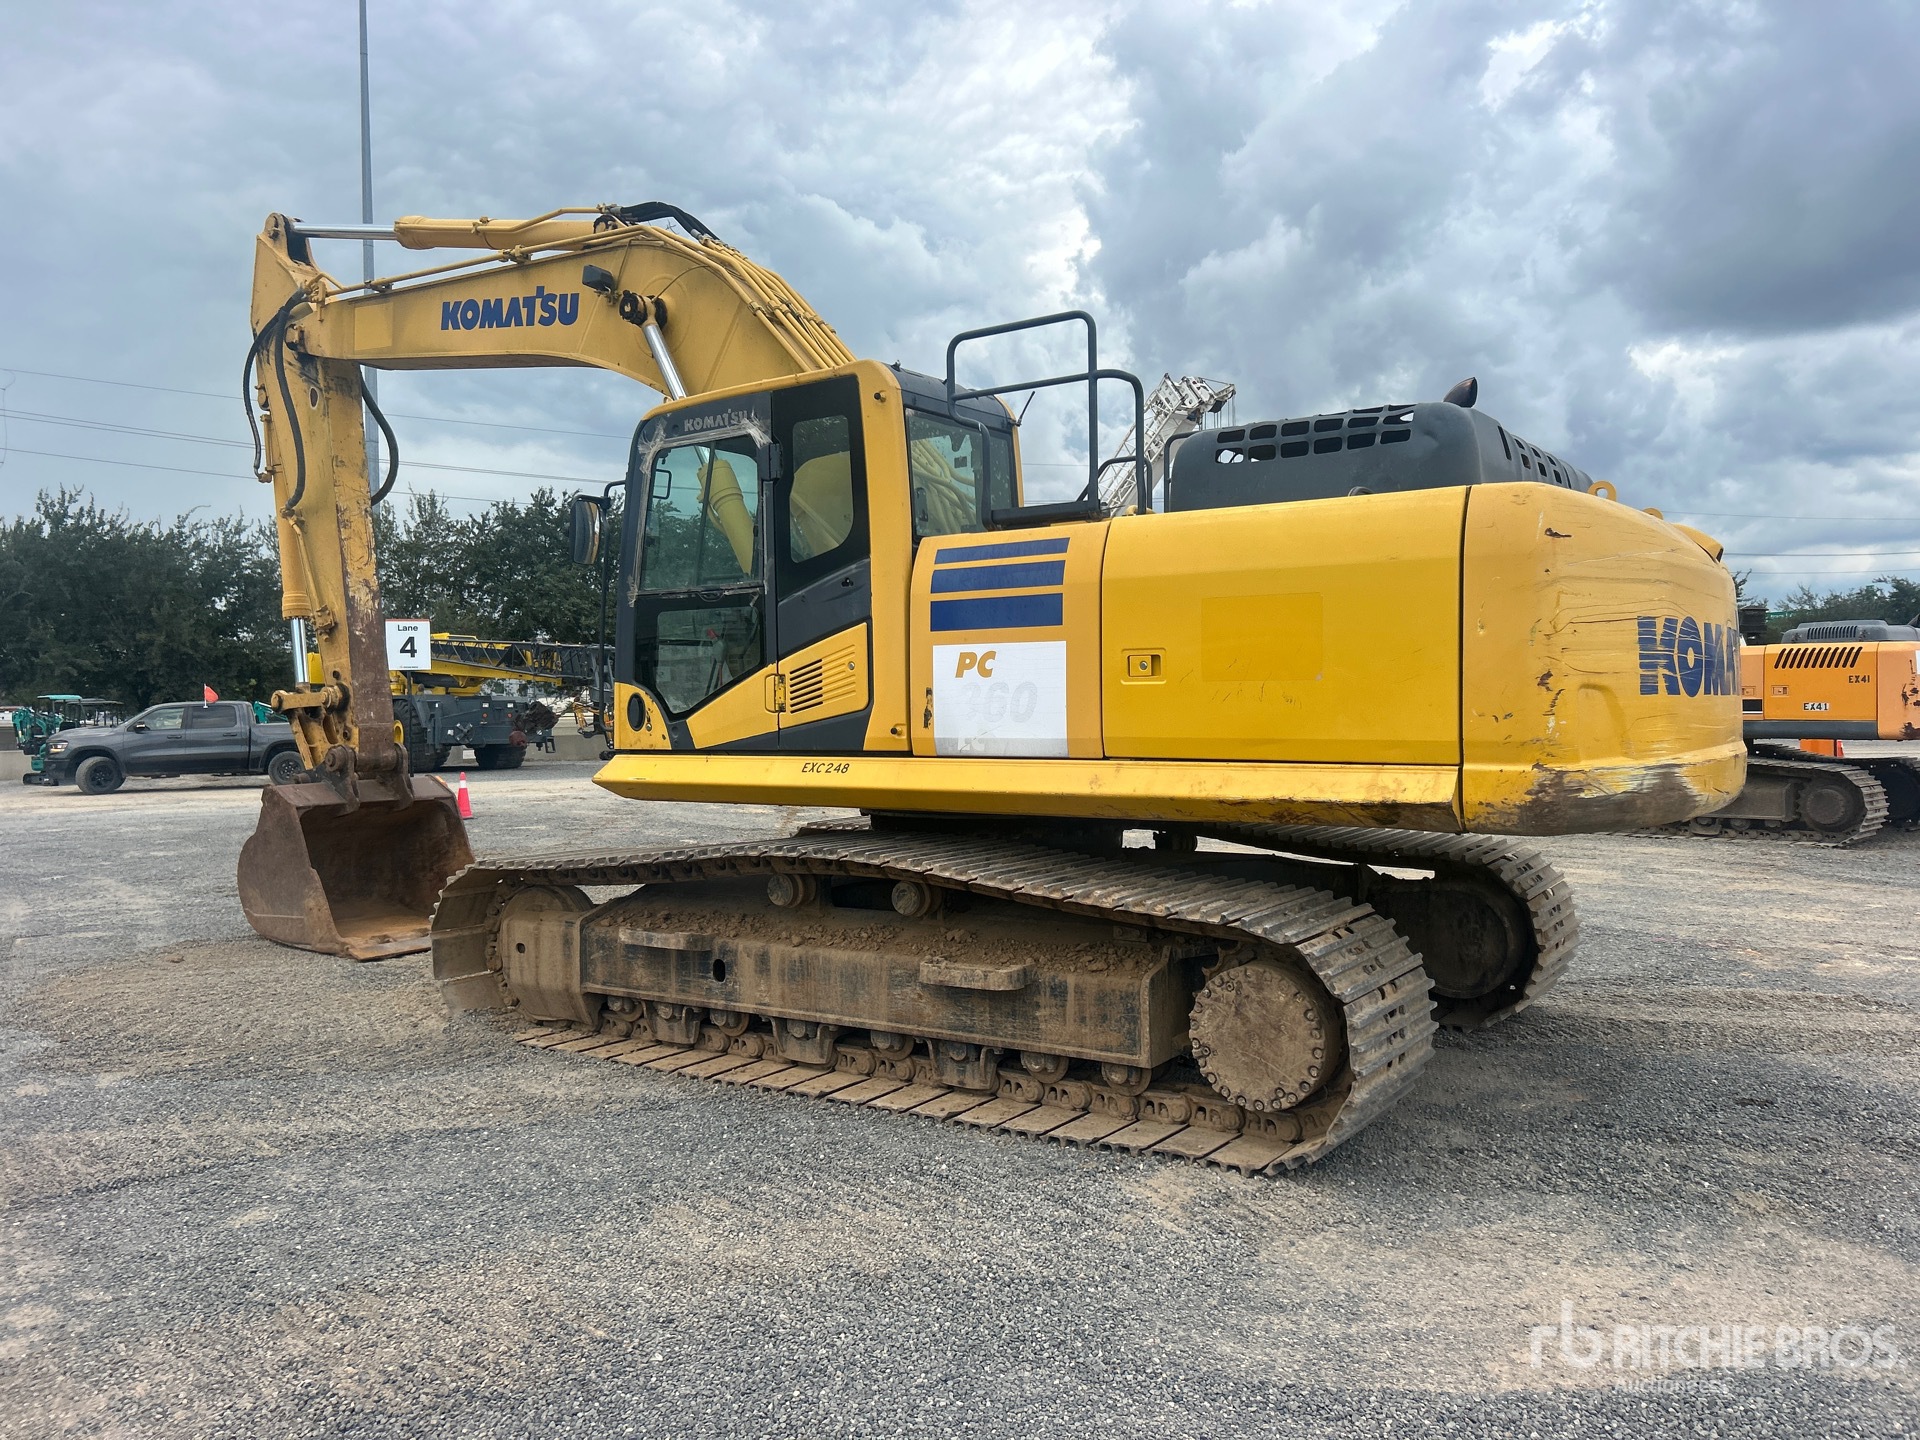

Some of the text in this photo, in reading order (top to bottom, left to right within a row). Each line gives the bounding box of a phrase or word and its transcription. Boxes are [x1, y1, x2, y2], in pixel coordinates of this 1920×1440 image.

[440, 285, 580, 331] KOMATSU
[684, 408, 748, 432] KOMATSU
[397, 624, 419, 632] Lane
[399, 636, 418, 658] 4
[955, 650, 997, 679] PC
[1848, 675, 1871, 684] EX41
[1803, 703, 1829, 711] EX41
[801, 762, 850, 774] EXC248
